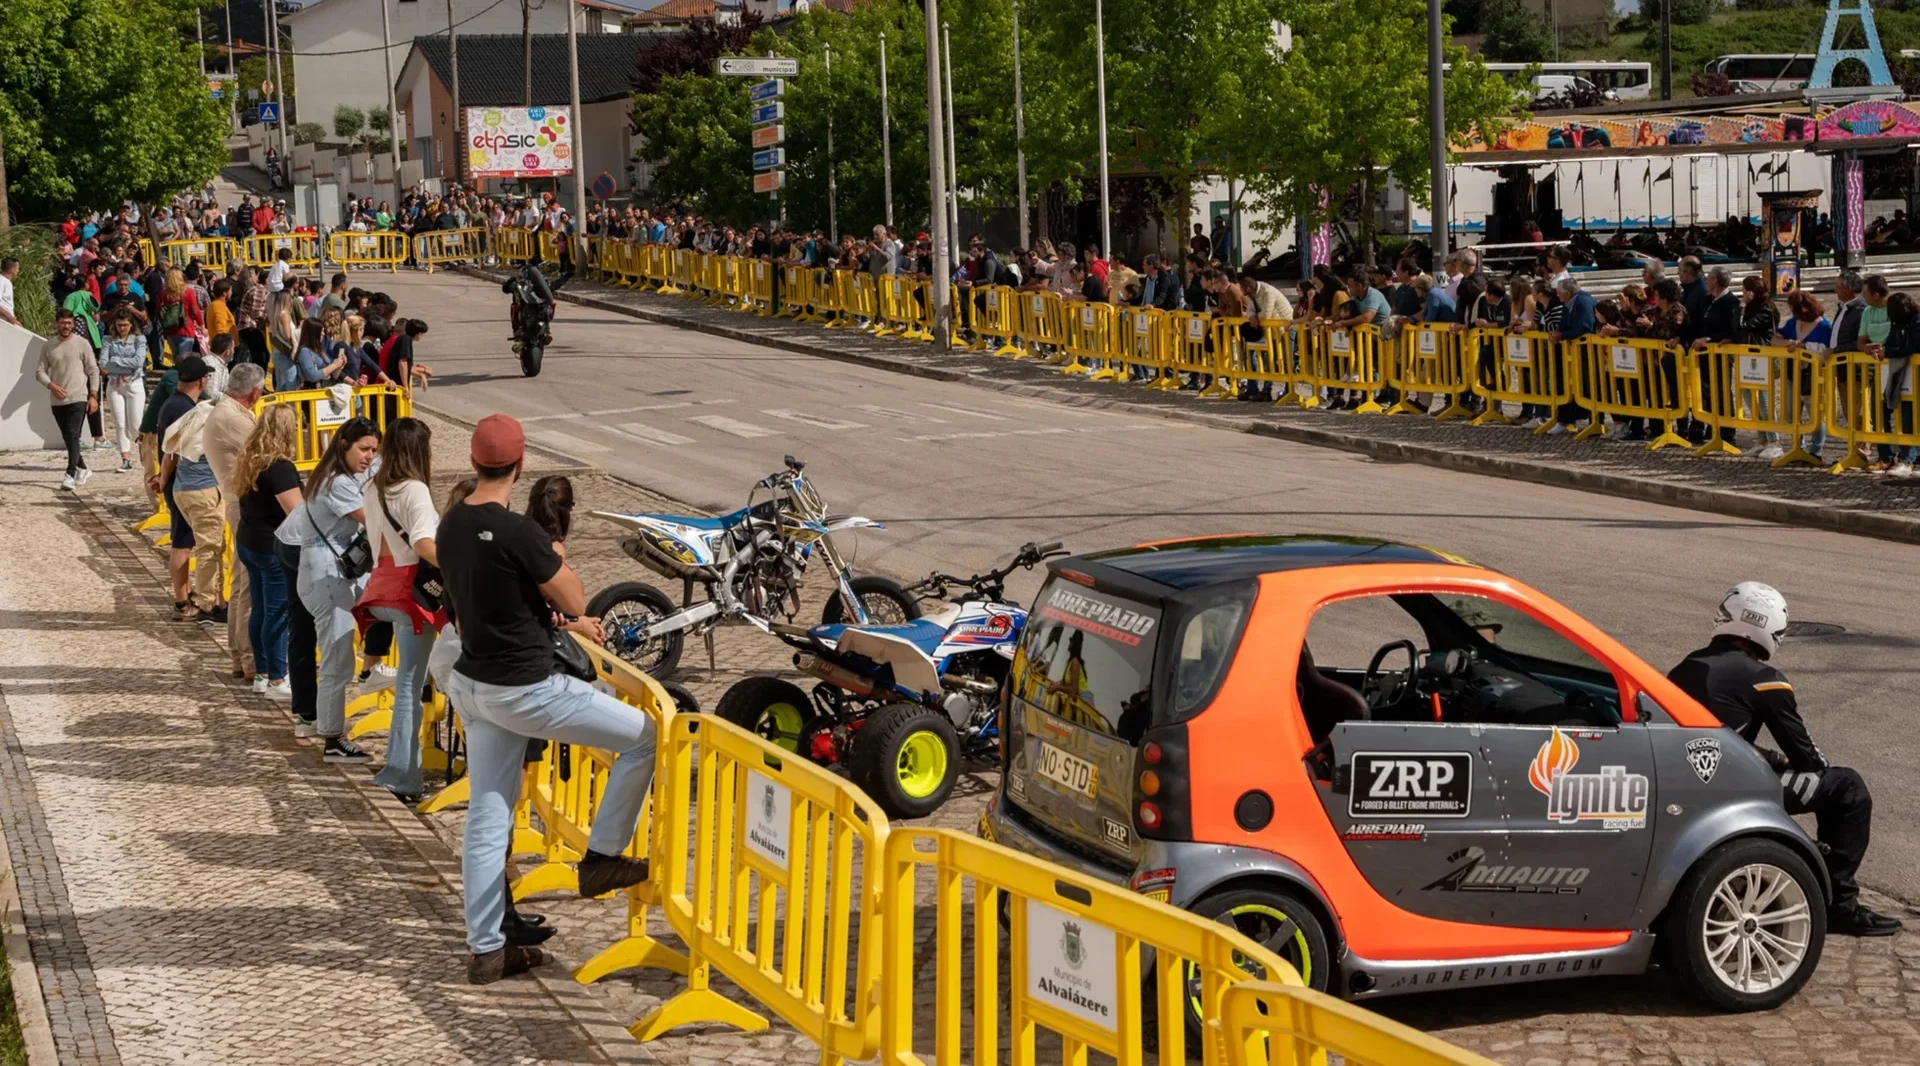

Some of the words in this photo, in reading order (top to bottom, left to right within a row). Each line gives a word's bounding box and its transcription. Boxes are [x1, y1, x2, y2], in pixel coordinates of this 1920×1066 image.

[762, 66, 796, 74] municipal
[1047, 588, 1156, 637] ARREPIADO
[1745, 611, 1764, 622] ZRP
[1369, 760, 1455, 797] ZRP
[1361, 800, 1383, 810] FORGED
[1388, 800, 1408, 810] BILLET
[1408, 800, 1428, 810] ENGINE
[1428, 800, 1459, 810] INTERNALS
[1550, 768, 1647, 821] ignite
[1106, 820, 1127, 842] ZRP
[1345, 823, 1425, 835] ARREPIADO
[1604, 819, 1628, 829] racing
[1630, 818, 1645, 828] fuel
[749, 829, 786, 860] Alvaiázere
[1408, 958, 1604, 986] ARREPIADO.COM
[1037, 976, 1109, 1017] Alvaiázere
